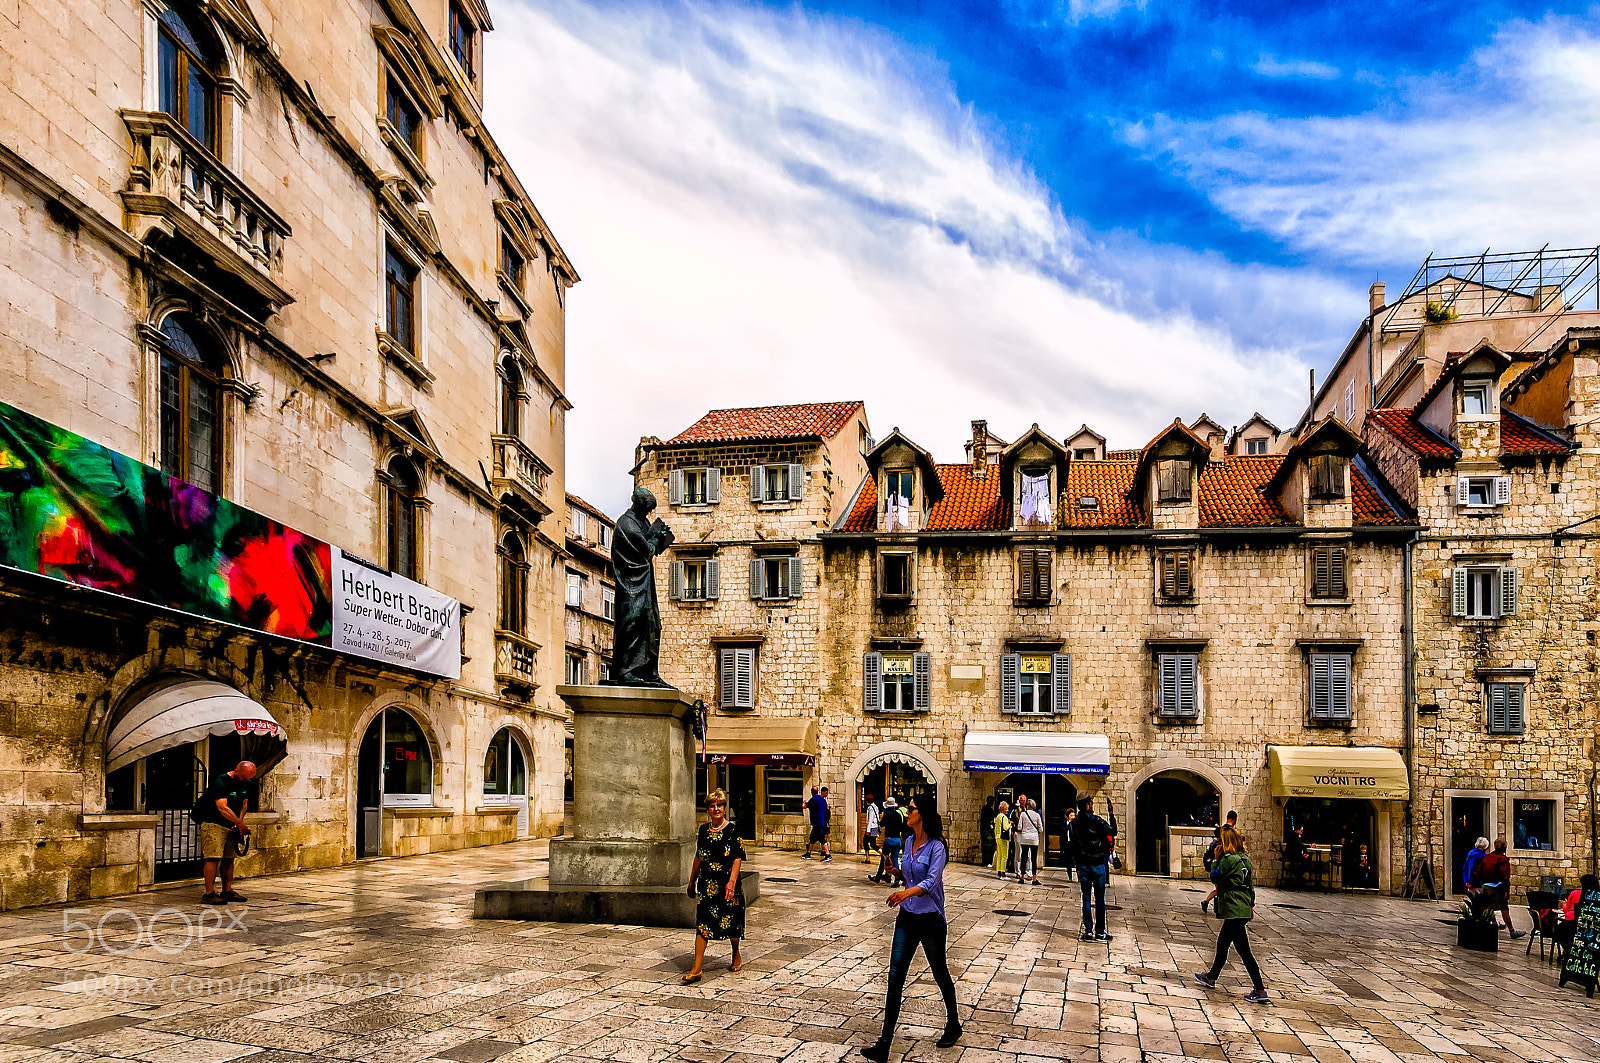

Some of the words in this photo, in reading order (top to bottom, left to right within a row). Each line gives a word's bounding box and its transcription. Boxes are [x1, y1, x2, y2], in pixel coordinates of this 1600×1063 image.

[341, 569, 405, 613] Herbert
[408, 595, 451, 628] Brandl
[343, 598, 373, 617] Super
[374, 607, 404, 628] Wetter.
[406, 618, 429, 636] Dobar
[342, 635, 362, 647] Zavod
[363, 641, 380, 653] HAZU
[384, 647, 405, 661] Galerija
[343, 622, 355, 634] 27.
[357, 627, 365, 638] 4.
[372, 630, 385, 642] 28.
[386, 635, 393, 646] 5.
[394, 637, 412, 650] 2017.
[1313, 773, 1350, 786] VOĆNI
[1351, 776, 1376, 786] TRG
